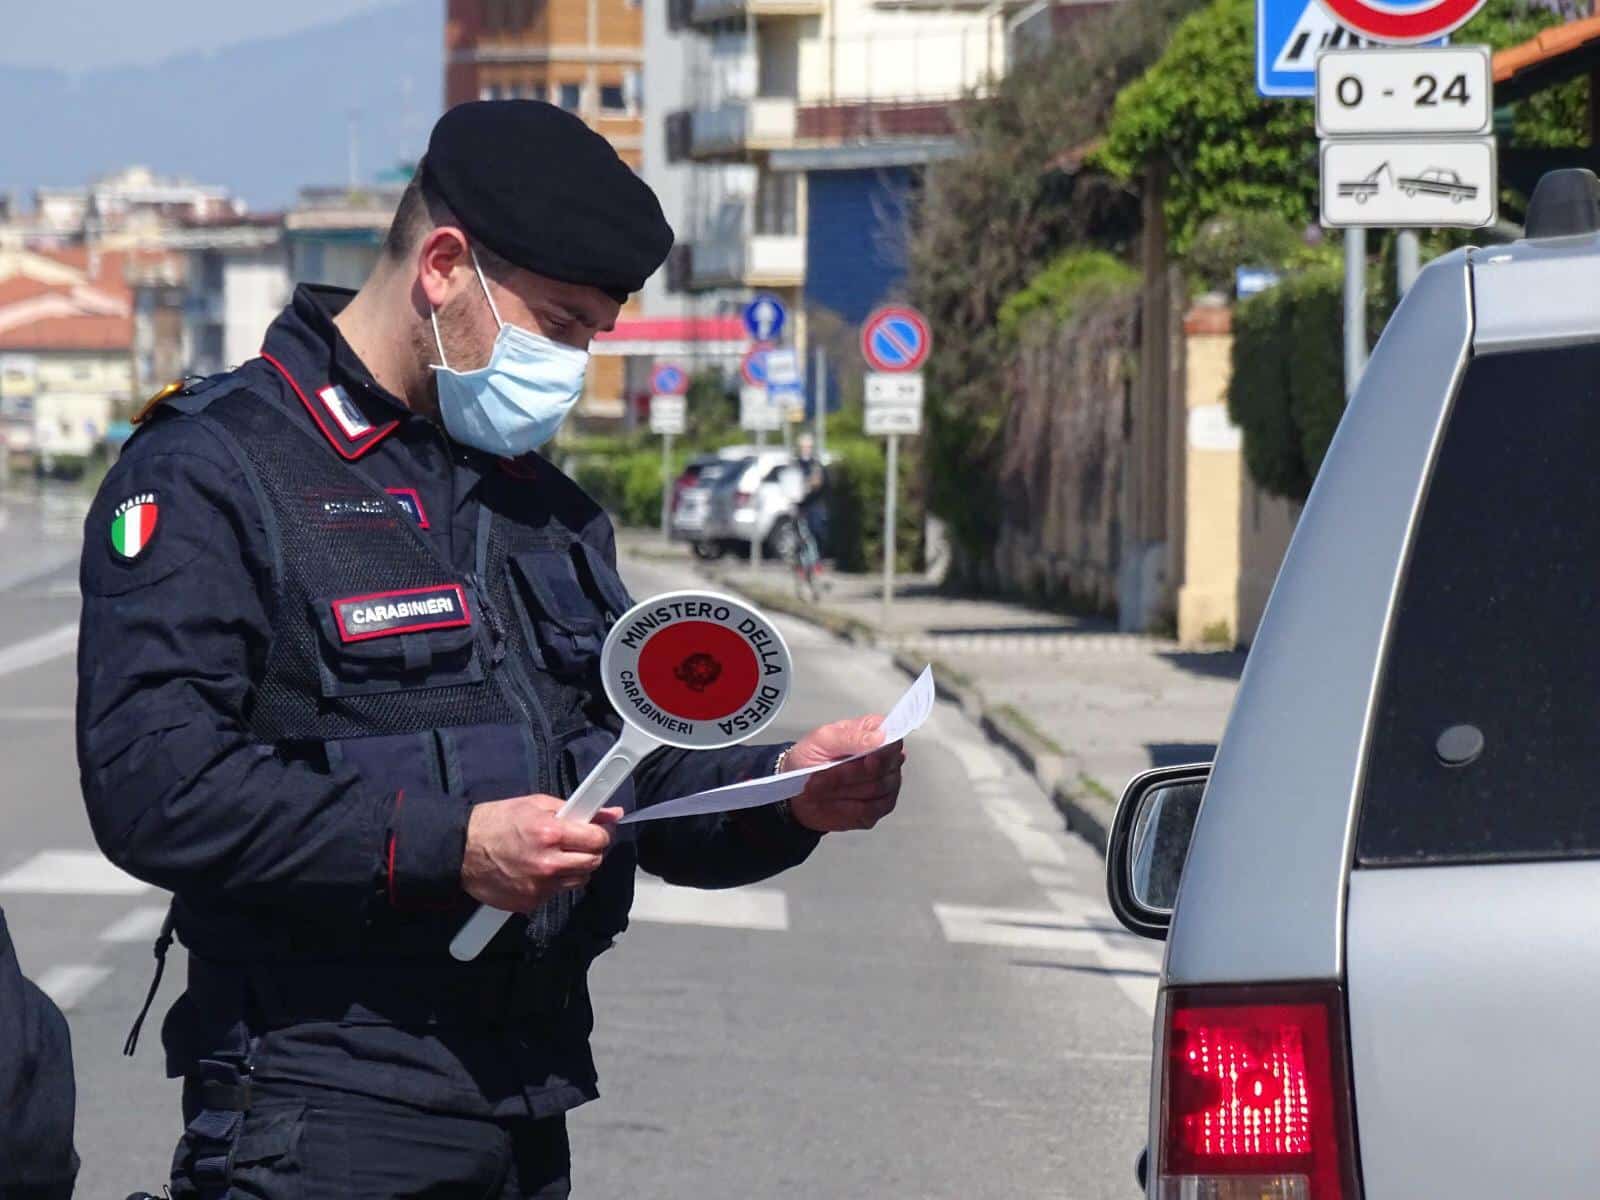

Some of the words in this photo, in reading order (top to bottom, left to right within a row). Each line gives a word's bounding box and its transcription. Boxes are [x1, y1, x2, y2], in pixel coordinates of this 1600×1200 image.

[1382, 89, 1395, 97] -
[1413, 73, 1471, 107] 24
[114, 493, 155, 518] ITALIA
[352, 597, 454, 625] CARABINIERI
[621, 602, 730, 649] MINISTERO
[737, 618, 782, 676] DELLA
[620, 670, 693, 735] CARABINIERI
[718, 684, 780, 736] DIFESA
